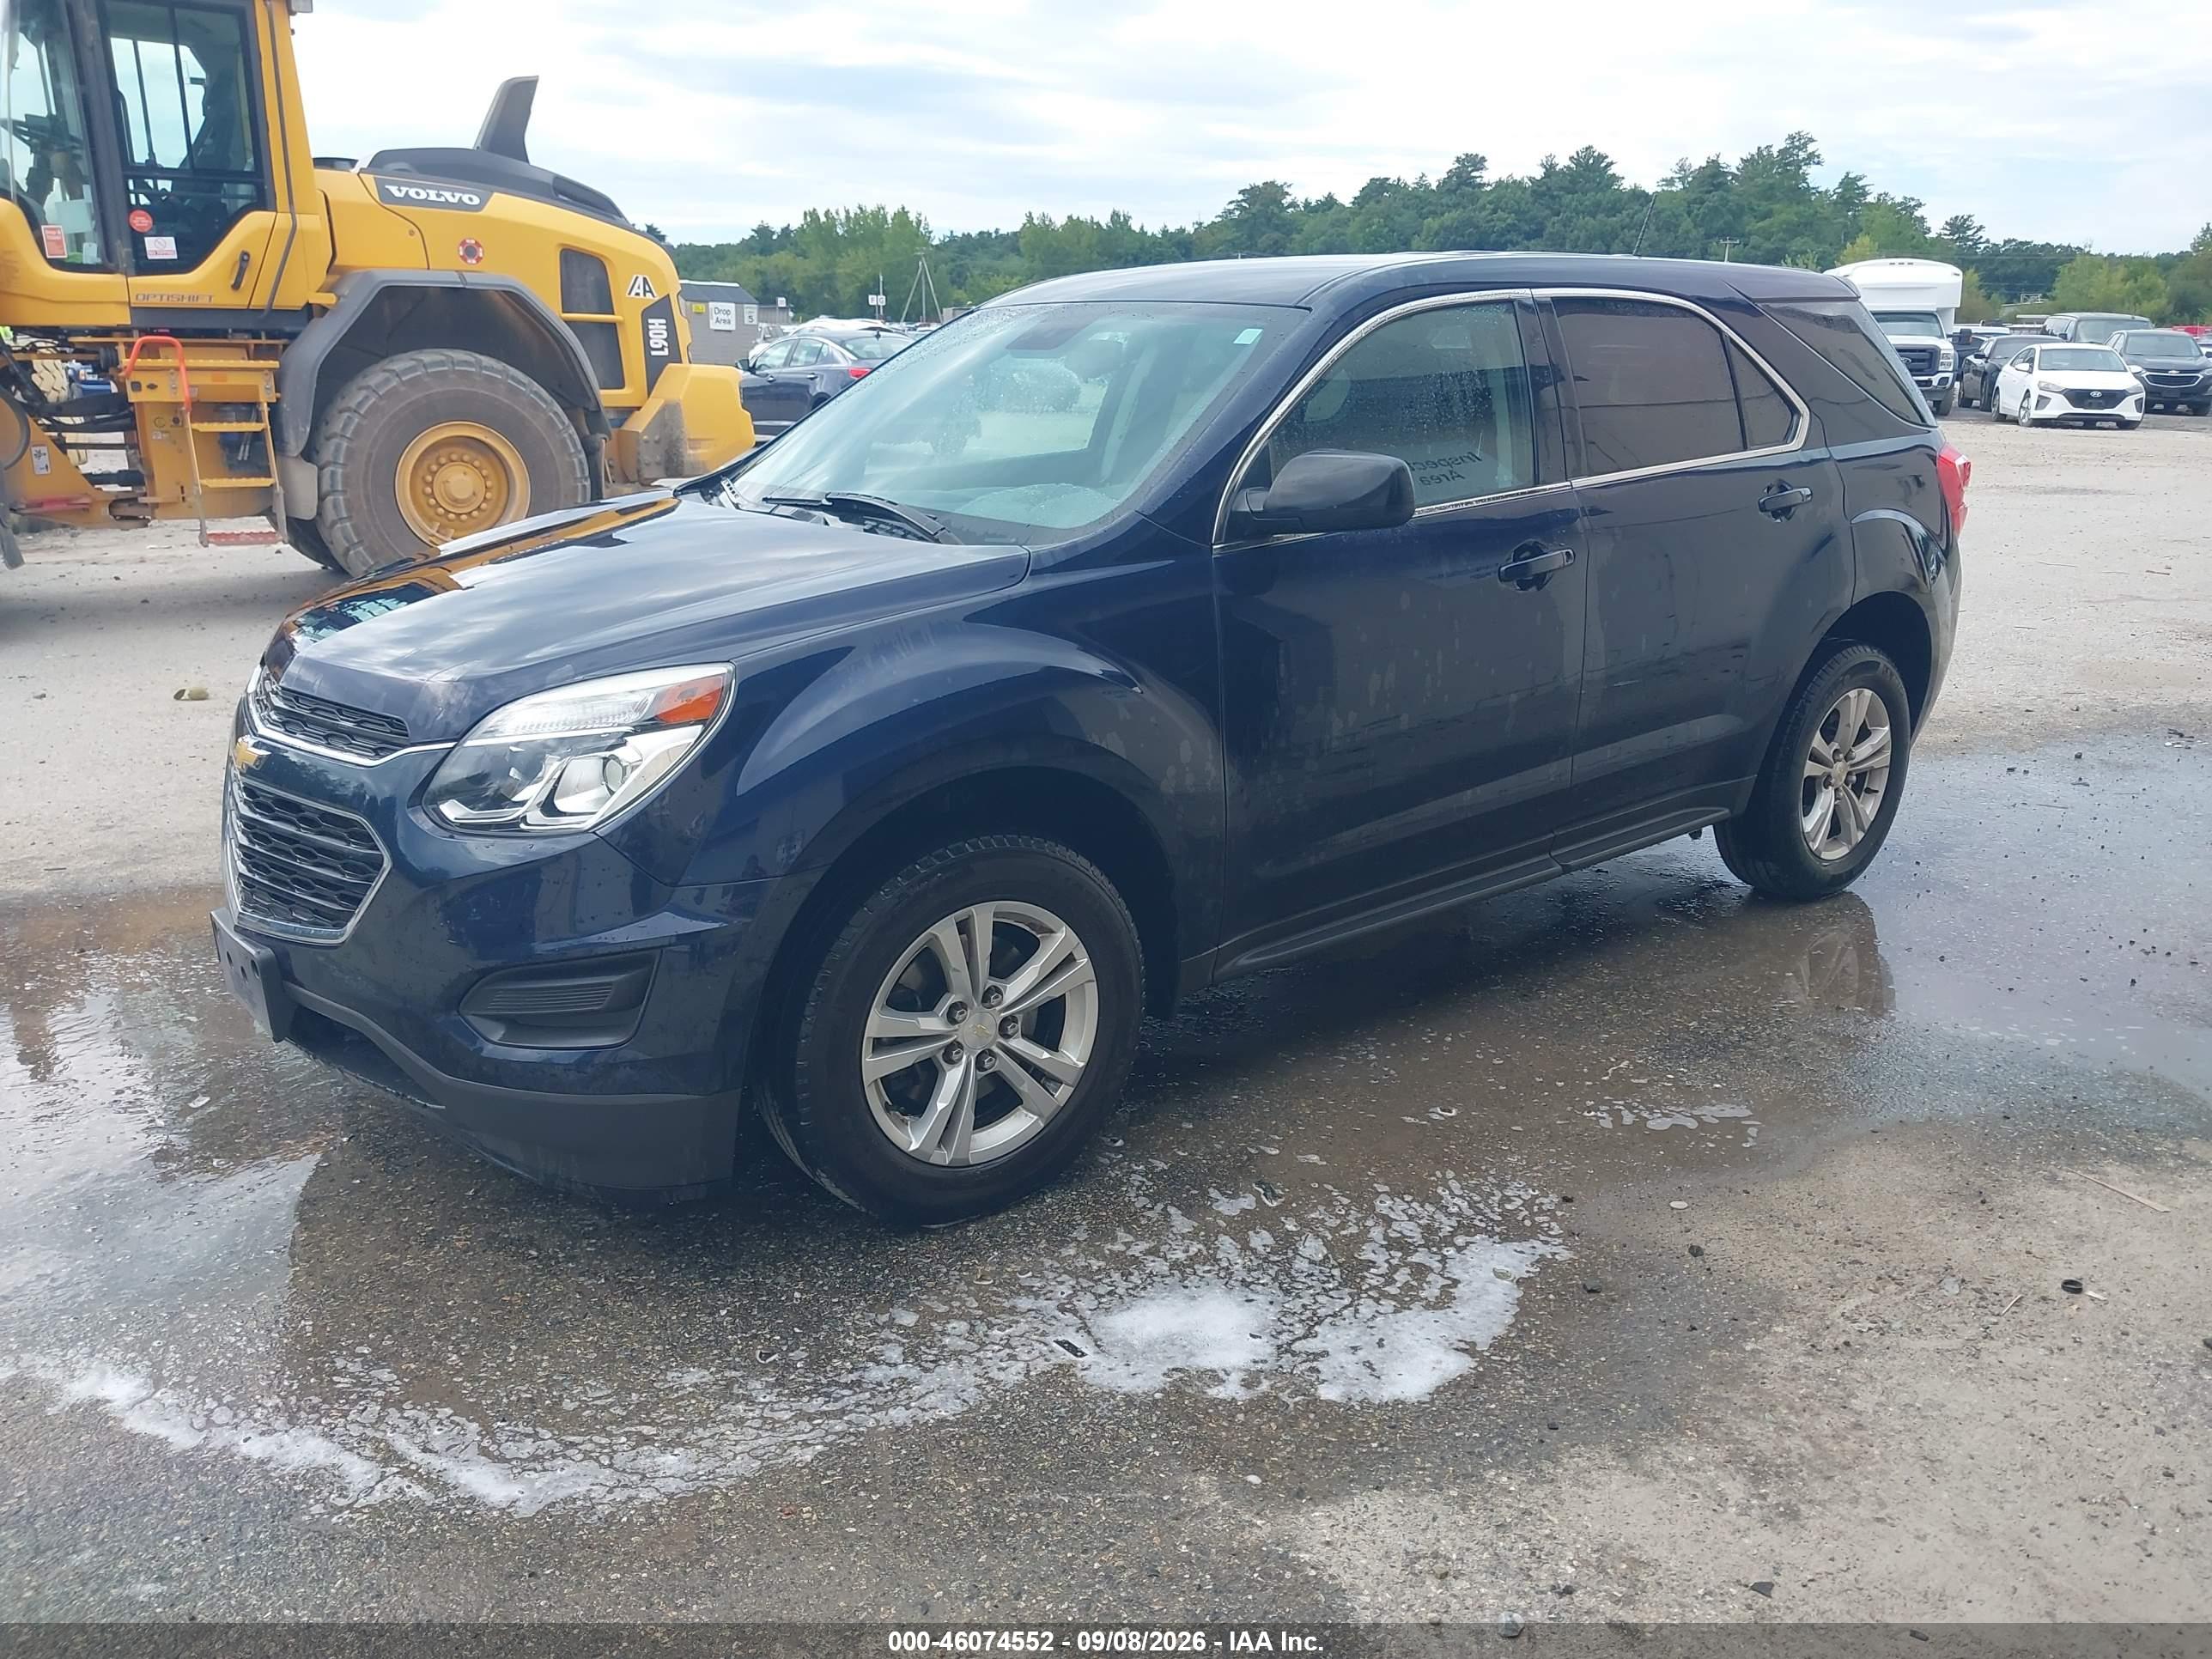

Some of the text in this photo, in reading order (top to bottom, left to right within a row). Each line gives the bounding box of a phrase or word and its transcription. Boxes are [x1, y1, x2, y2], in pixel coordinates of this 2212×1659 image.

[385, 185, 481, 205] VOLVO
[714, 307, 732, 316] Drop
[714, 316, 732, 325] Area
[647, 318, 669, 356] L90H
